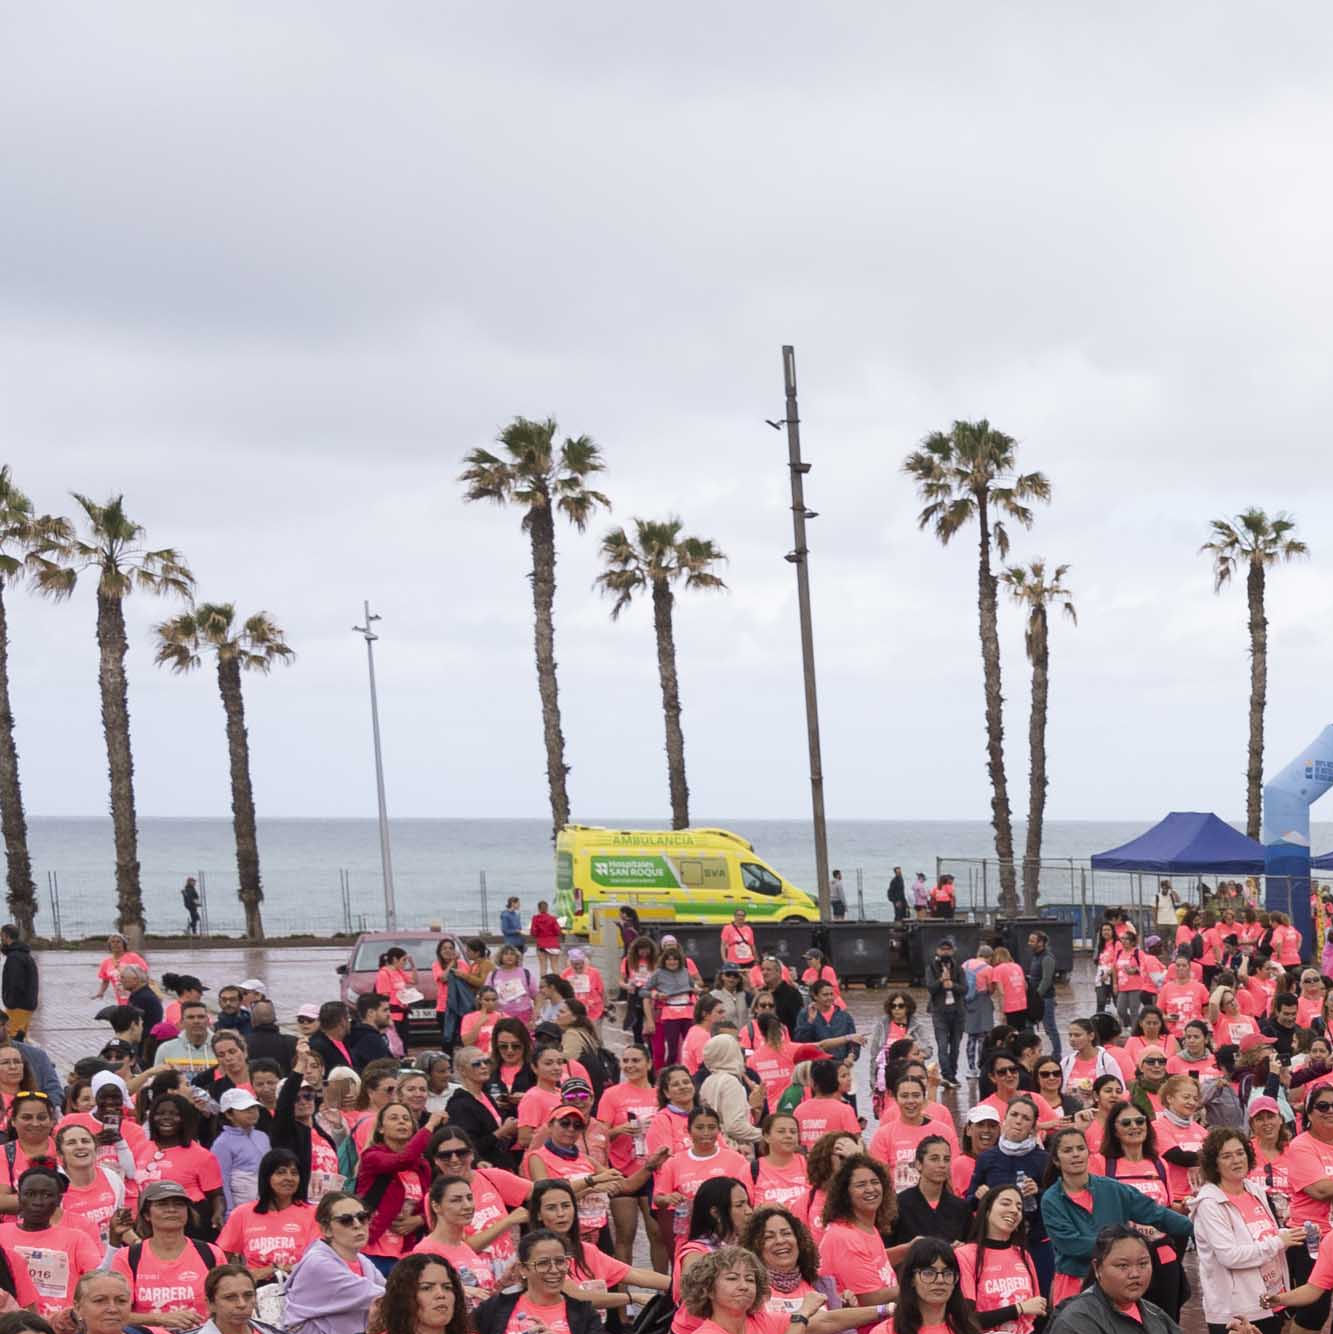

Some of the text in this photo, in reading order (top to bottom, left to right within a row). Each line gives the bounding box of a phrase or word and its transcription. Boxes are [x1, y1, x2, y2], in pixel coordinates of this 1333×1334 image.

[612, 836, 695, 846] AMBULANCIA
[608, 868, 664, 877] SAN ROQUE
[249, 1236, 296, 1251] CARRERA
[985, 1277, 1030, 1294] CARRERA
[138, 1287, 195, 1301] CARRERA
